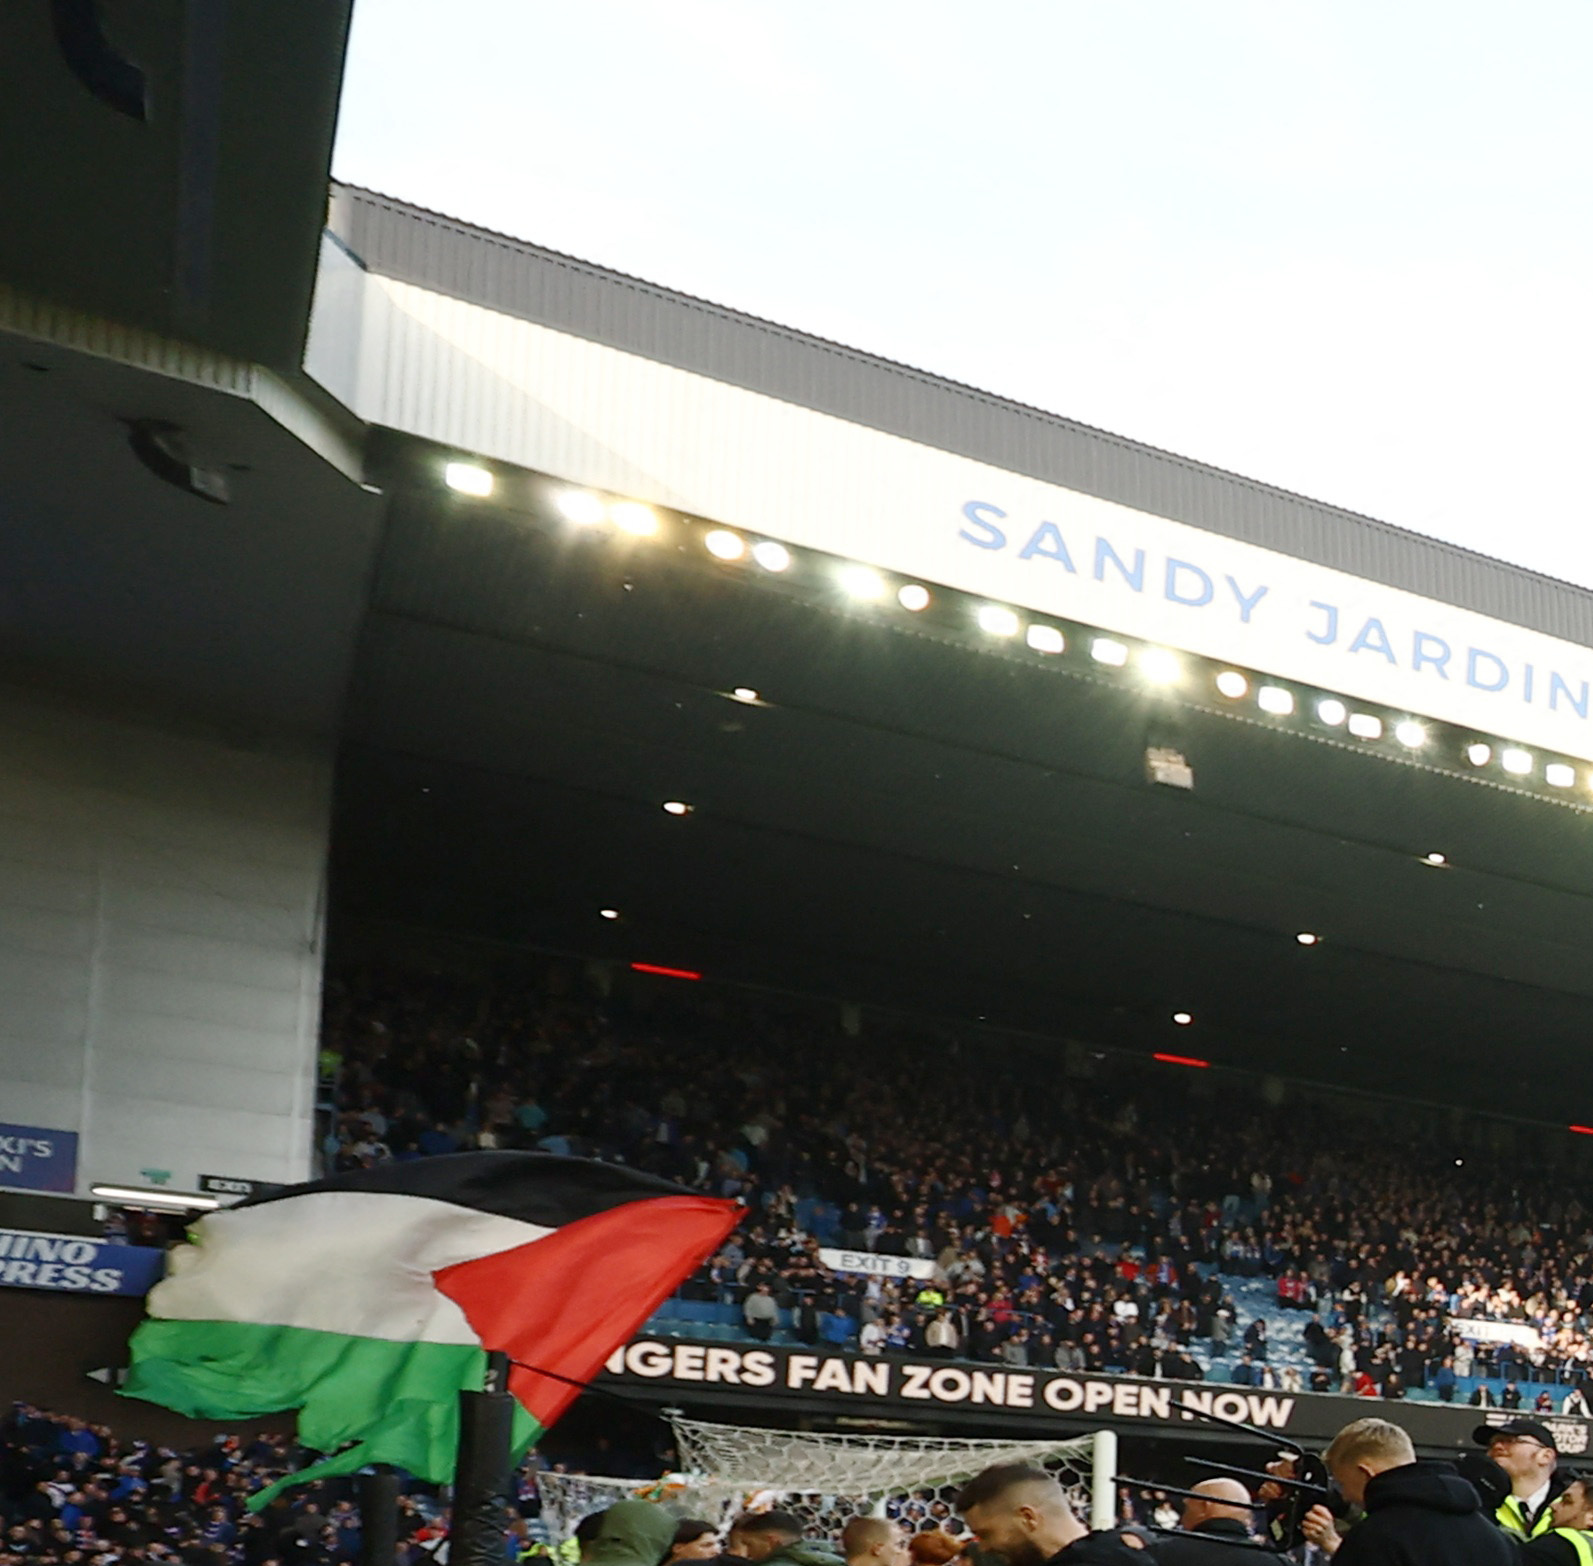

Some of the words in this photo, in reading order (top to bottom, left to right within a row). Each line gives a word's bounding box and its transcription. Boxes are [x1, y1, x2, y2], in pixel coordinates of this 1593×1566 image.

[959, 500, 1268, 624] SANDY
[840, 1252, 892, 1269] EXIT
[897, 1261, 910, 1276] 9
[604, 1341, 777, 1386] NGERS
[787, 1355, 890, 1396] FAN
[901, 1365, 1034, 1408] ZONE
[1043, 1377, 1171, 1419] OPEN
[1181, 1389, 1295, 1428] NOW
